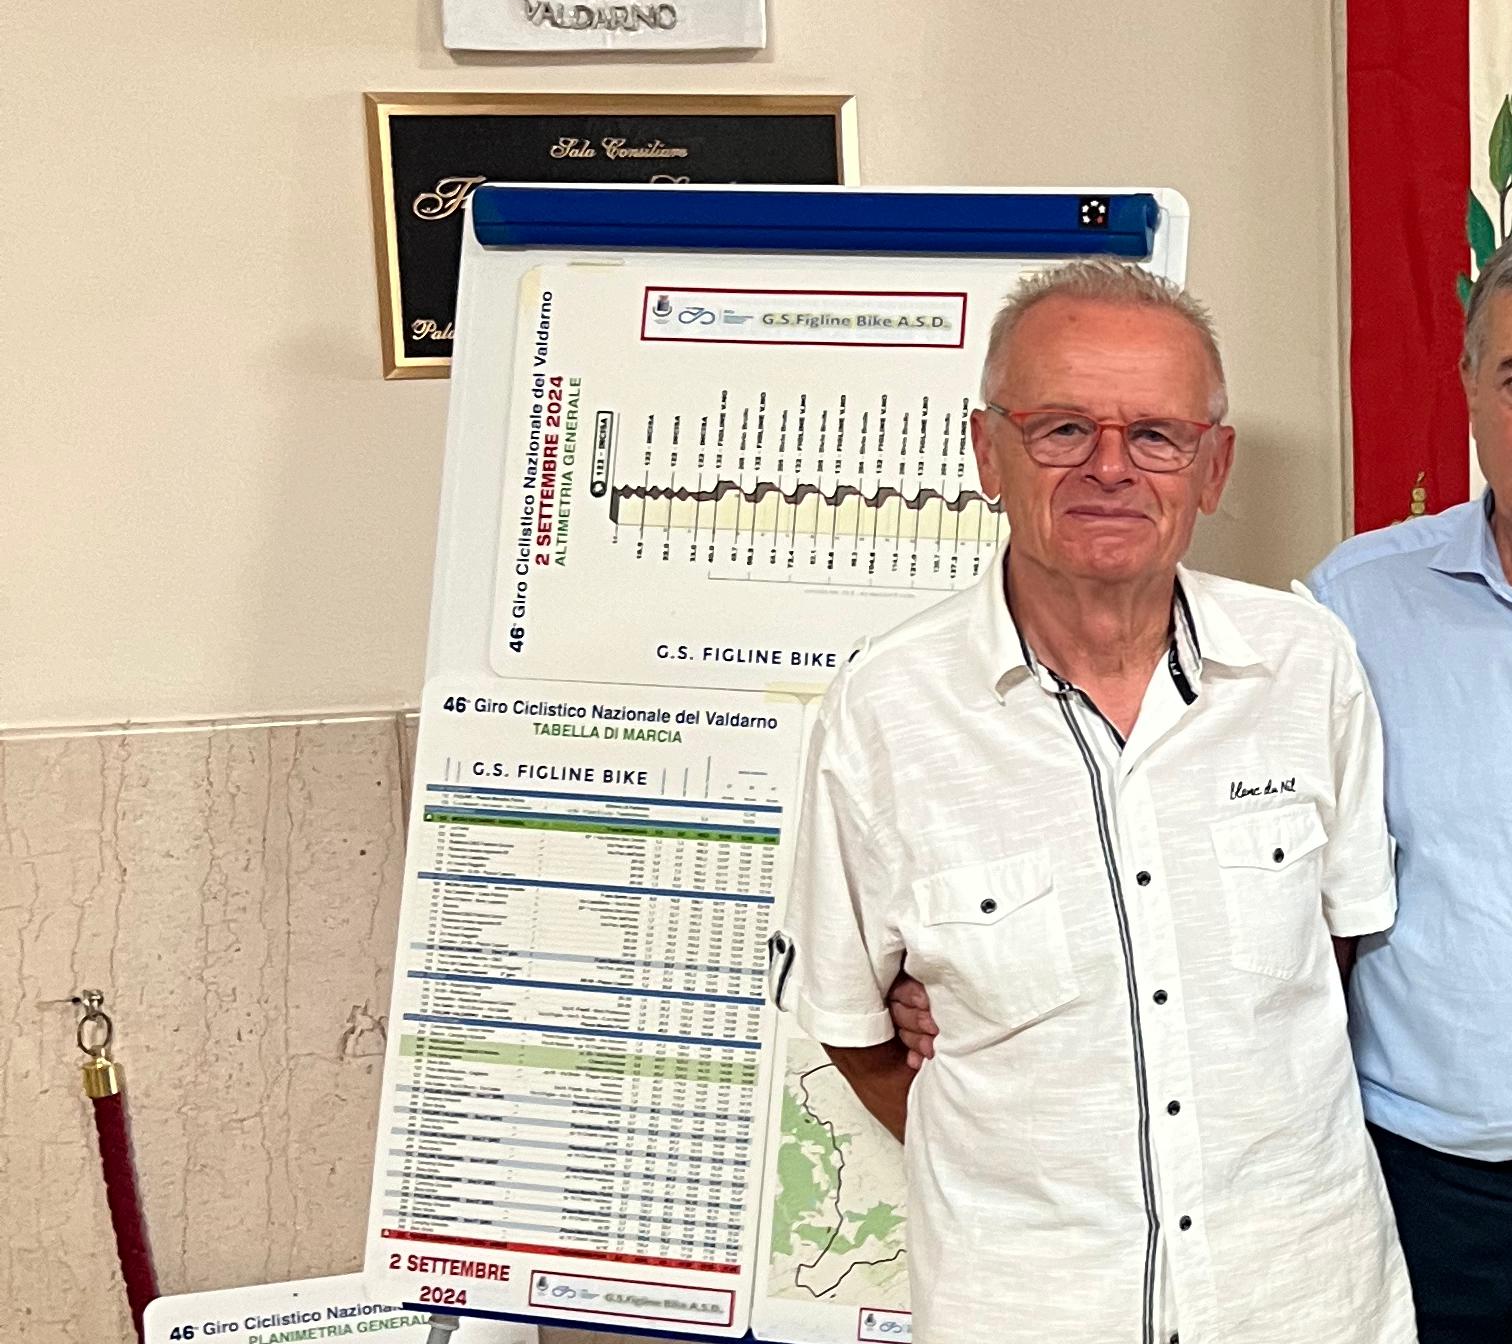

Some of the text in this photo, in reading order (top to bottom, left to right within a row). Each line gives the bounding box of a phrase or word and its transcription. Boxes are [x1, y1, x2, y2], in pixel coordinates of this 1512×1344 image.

[550, 137, 597, 159] Sala
[534, 290, 553, 367] Valdarno
[856, 314, 892, 329] Bike
[531, 373, 545, 399] del
[523, 405, 543, 490] Nazionale
[535, 375, 564, 567] 2 SETTEMBRE 2024
[555, 376, 582, 567] ALTIMETRIA GENERALE
[516, 494, 535, 575] Ciclistico
[512, 581, 528, 619] Giro
[656, 644, 694, 661] G.S.
[703, 647, 782, 665] FIGLINE
[791, 651, 837, 668] BIKE
[474, 697, 508, 715] Giro
[513, 700, 587, 719] Ciclistico
[592, 705, 671, 724] Nazionale
[675, 710, 700, 725] del
[705, 711, 778, 730] Valdarno
[533, 722, 683, 744] TABELLA DI MARCIA
[472, 761, 509, 778] G.S.
[517, 764, 594, 784] FIGLINE
[603, 768, 649, 786] BIKE
[389, 1253, 511, 1282] 2 SETTEMBRE
[419, 1285, 468, 1306] 2024
[203, 1320, 239, 1337] Giro
[244, 1310, 321, 1331] Ciclistico
[326, 1303, 402, 1320] Naziona
[356, 1314, 430, 1334] GENERAL
